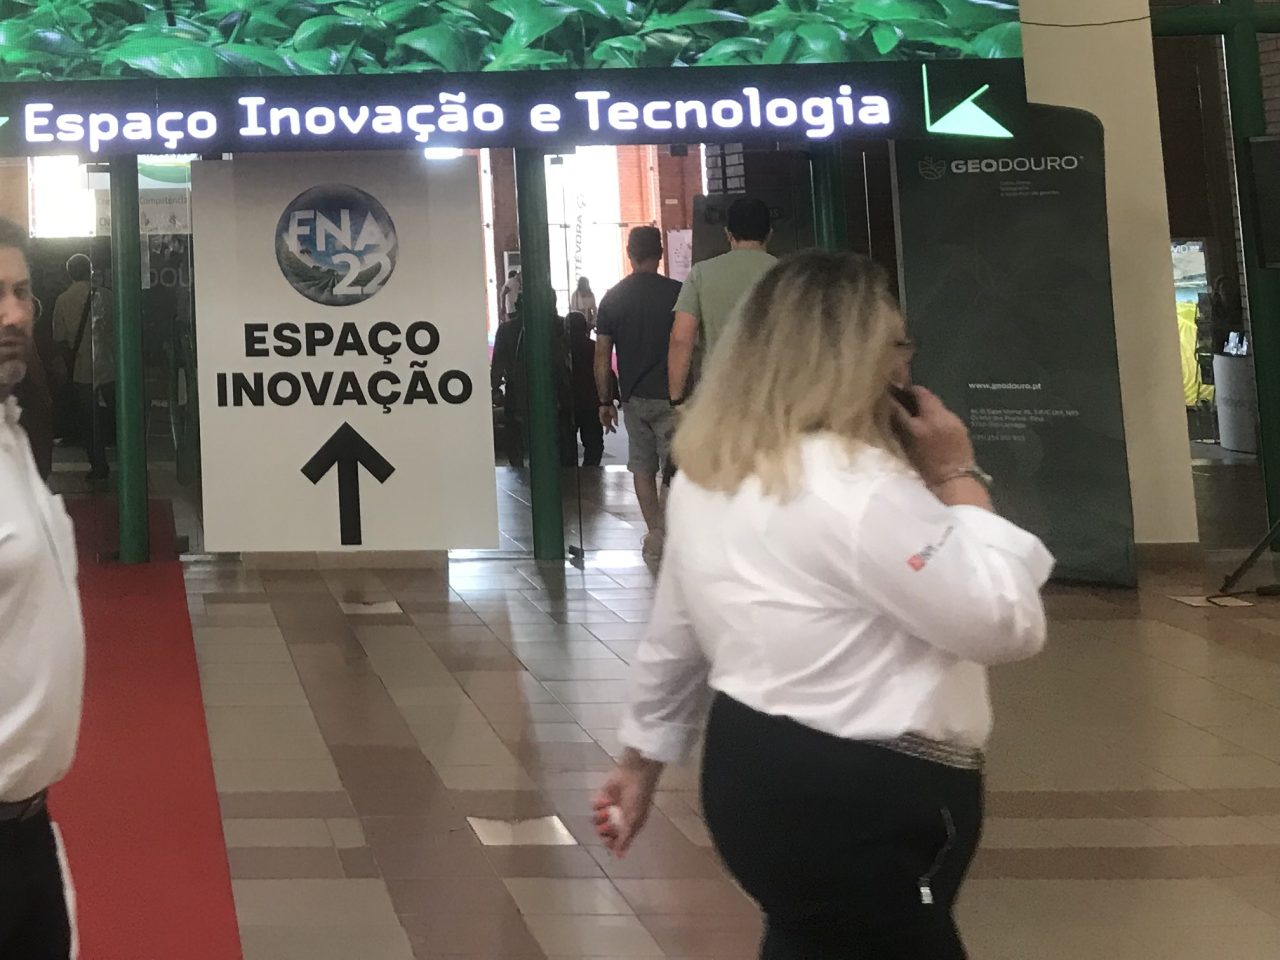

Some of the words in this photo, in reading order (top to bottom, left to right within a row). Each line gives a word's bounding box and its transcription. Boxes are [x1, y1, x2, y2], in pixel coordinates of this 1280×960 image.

[24, 102, 218, 149] Espaço
[237, 92, 505, 142] Inovação
[529, 104, 562, 133] e
[575, 84, 891, 139] Tecnologia
[950, 155, 1079, 173] GEODOURO
[331, 252, 392, 295] 22
[244, 320, 441, 365] ESPAÇO
[216, 360, 473, 415] INOVAÇÃO
